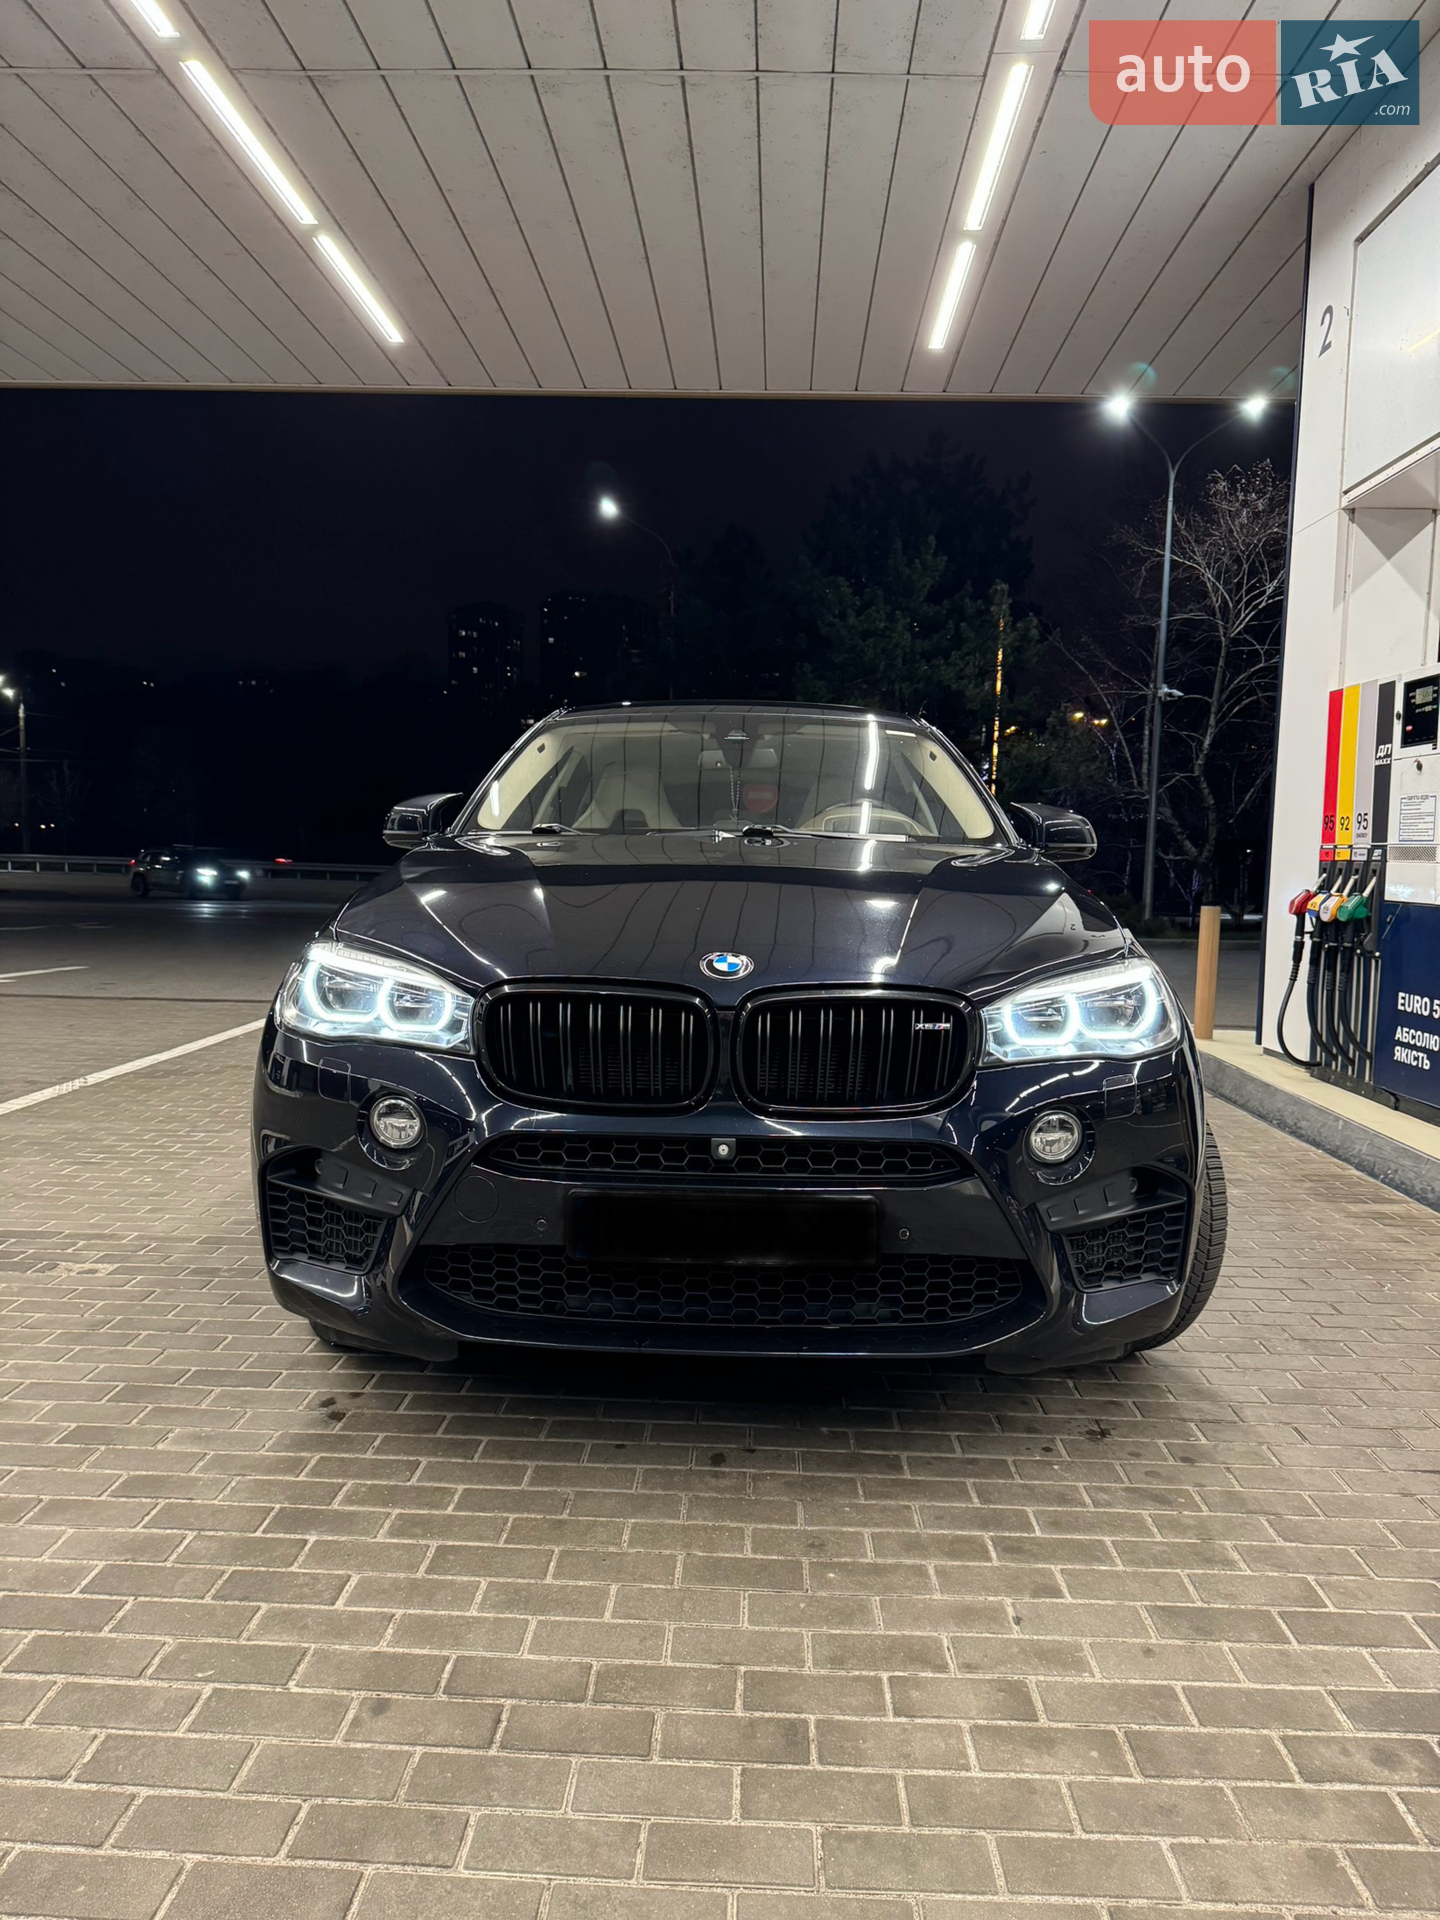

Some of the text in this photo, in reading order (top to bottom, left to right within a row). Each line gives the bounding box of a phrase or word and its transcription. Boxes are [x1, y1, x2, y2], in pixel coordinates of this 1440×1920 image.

[1318, 304, 1334, 359] 2
[1376, 743, 1392, 759] ДП
[1323, 814, 1335, 832] 95
[1339, 816, 1350, 831] 92
[1356, 812, 1369, 831] 95
[1397, 991, 1440, 1019] EURO 5
[1394, 1025, 1440, 1052] АБСОЛЮ
[1393, 1045, 1431, 1070] ЯКІСТЬ
